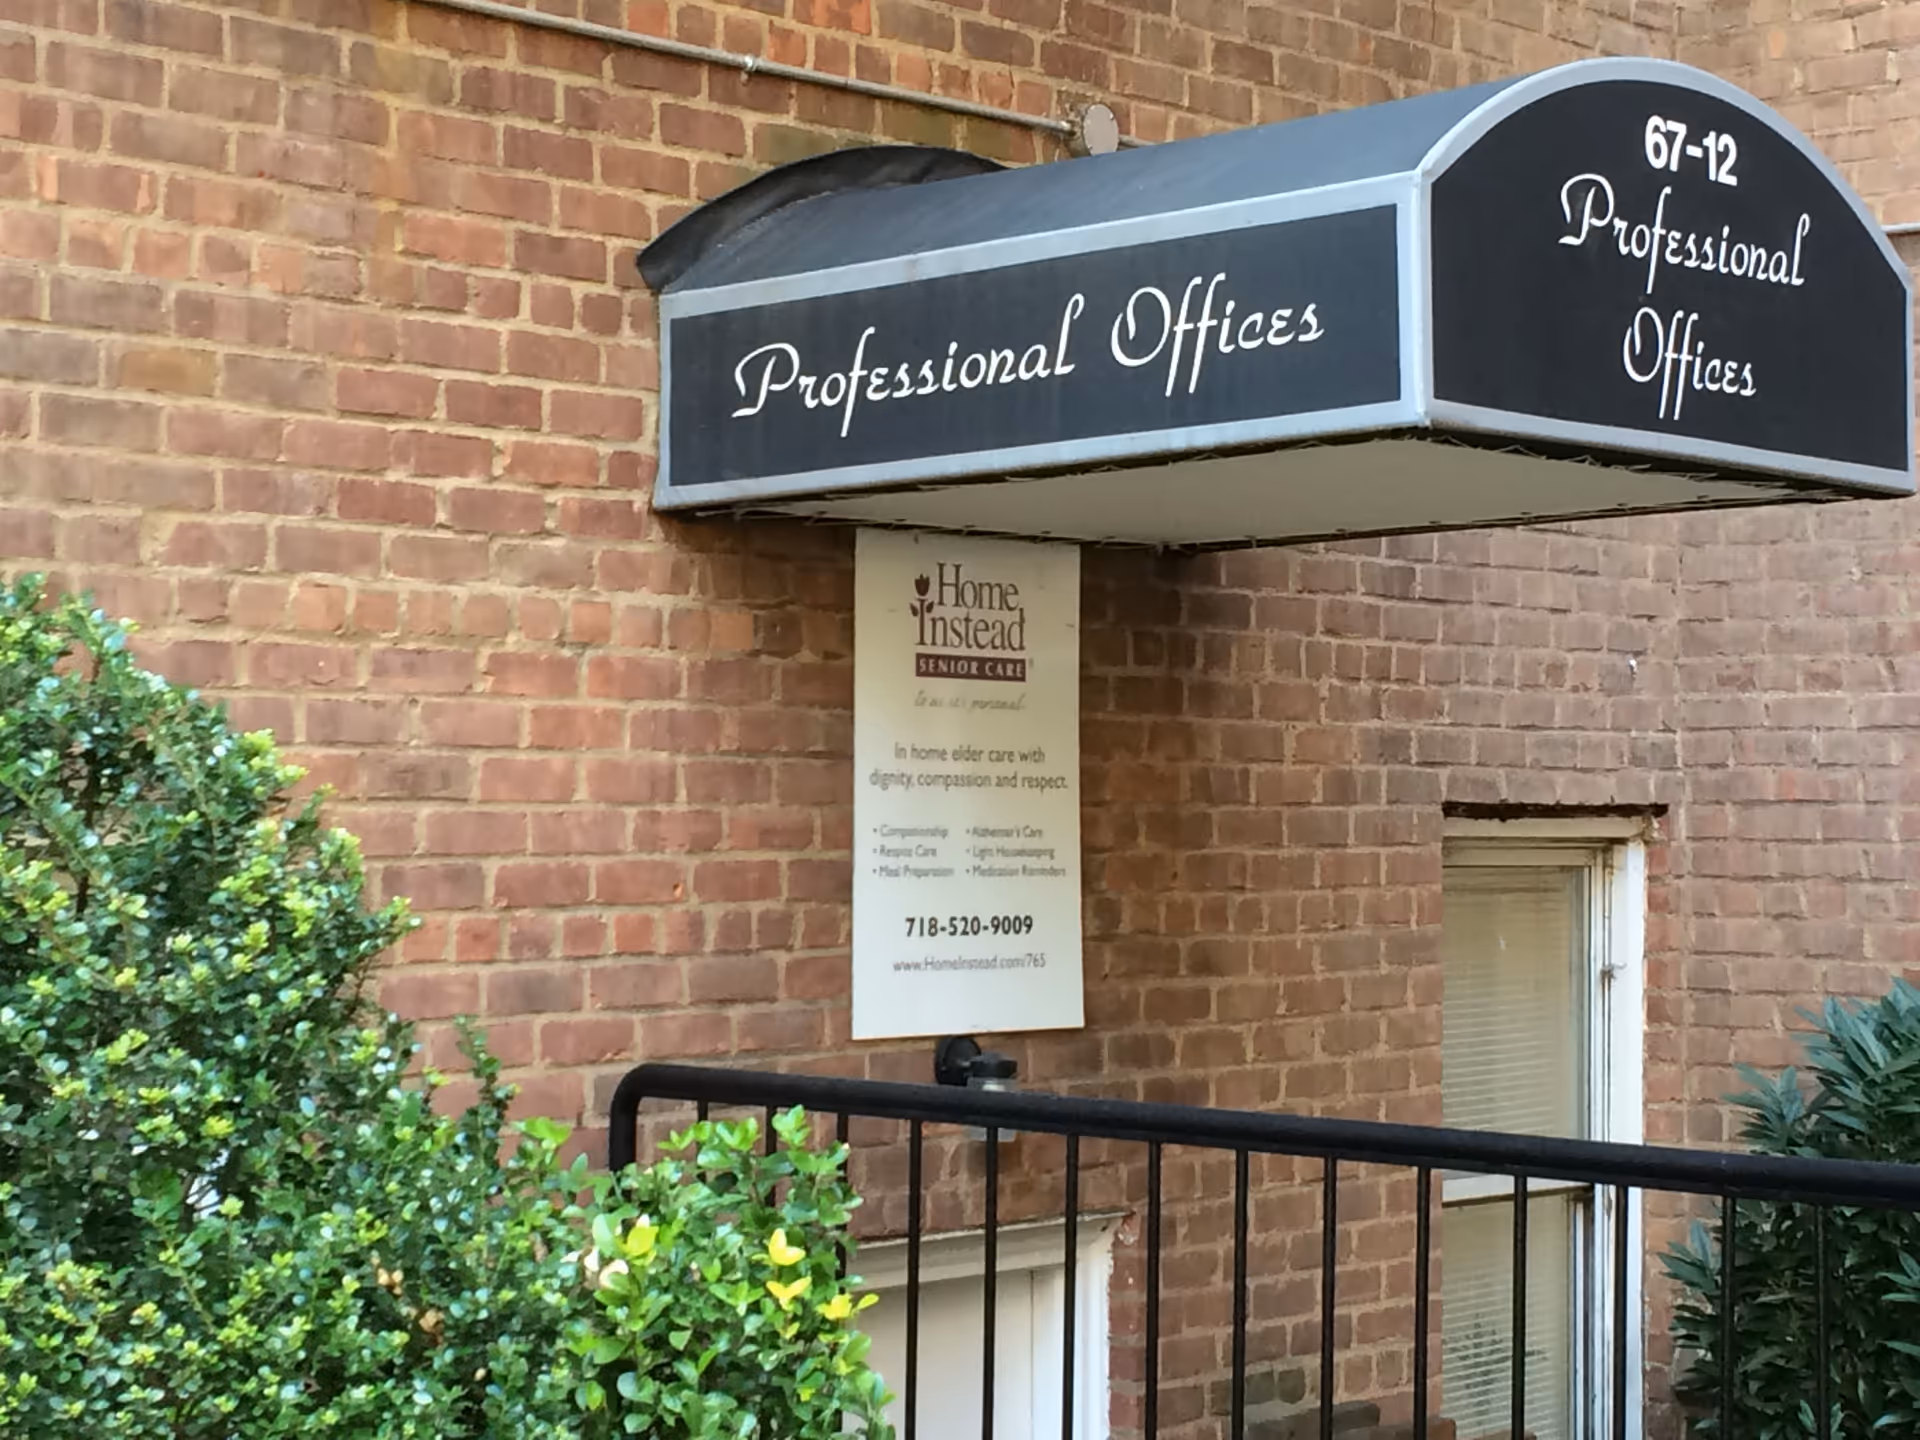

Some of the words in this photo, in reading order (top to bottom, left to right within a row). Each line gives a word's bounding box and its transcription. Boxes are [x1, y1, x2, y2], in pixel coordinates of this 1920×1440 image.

[1645, 115, 1738, 186] 67-12
[1558, 173, 1810, 295] Professional
[731, 293, 1084, 438] Professional
[1110, 272, 1324, 398] Offices
[1623, 306, 1757, 420] Offices
[937, 562, 1020, 612] Home
[912, 600, 1026, 652] Instead
[918, 657, 979, 676] SENIOR
[984, 661, 1024, 679] CARE
[894, 742, 908, 760] In
[911, 744, 948, 762] home
[951, 745, 984, 763] elder
[988, 748, 1016, 763] care
[1018, 747, 1046, 764] with
[917, 774, 992, 791] compassion
[995, 772, 1018, 789] and
[905, 915, 1033, 937] 718-520-9009
